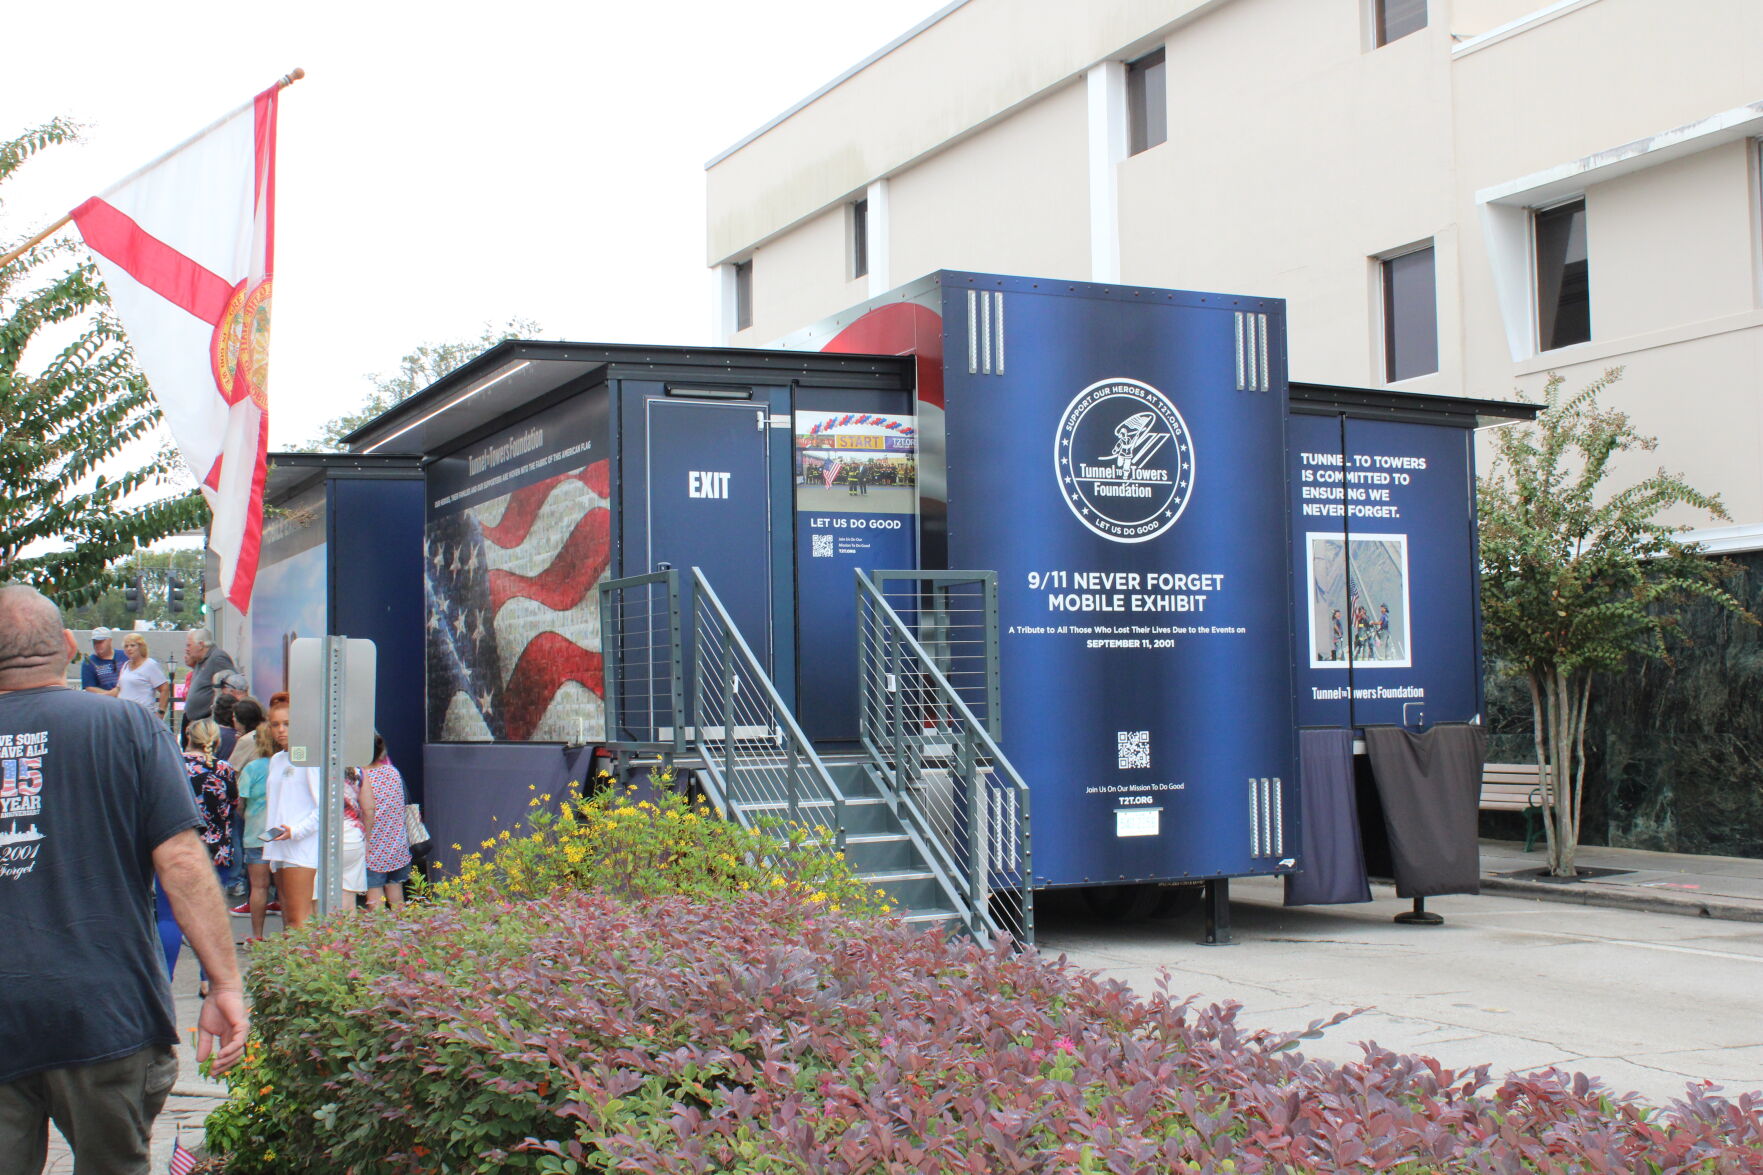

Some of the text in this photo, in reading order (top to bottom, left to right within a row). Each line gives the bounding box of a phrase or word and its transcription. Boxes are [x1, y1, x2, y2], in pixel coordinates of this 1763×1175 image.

[1065, 385, 1182, 436] SUPPORT OUR HEROES AT T2T.ORG
[510, 427, 543, 459] Foundation
[840, 435, 880, 448] START
[548, 455, 554, 464] OF
[553, 451, 562, 462] THIS
[561, 444, 581, 459] AMERICAN
[580, 440, 592, 452] FLAG
[1354, 455, 1371, 467] TO
[1374, 456, 1426, 469] TOWERS
[1080, 463, 1115, 478] Tunnel
[1131, 465, 1168, 480] Towers
[1302, 469, 1410, 485] IS COMMITTED TO
[688, 471, 731, 499] EXIT
[1094, 482, 1152, 498] Foundation
[1302, 486, 1390, 501] ENSURNG WE
[1303, 503, 1400, 518] NEVER FORGET.
[810, 518, 902, 529] LET US DO GOOD
[1095, 518, 1110, 531] LET
[1111, 526, 1122, 535] US
[1136, 520, 1160, 535] GOOD
[1027, 571, 1224, 591] 9/11 NEVER FORGET
[1048, 594, 1207, 612] MOBILE EXHIBIT
[1008, 626, 1245, 634] A Tribute to All Those Who Lost Their Lives Due to the Events on
[1086, 639, 1175, 649] SEPTEMBER 11, 2001
[1312, 687, 1342, 700] Tunnel
[1346, 686, 1377, 699] Twers
[1377, 685, 1424, 699] Foundation
[15, 731, 48, 746] SOME
[0, 743, 48, 758] AVE ALL
[0, 757, 43, 797] 15
[1129, 784, 1151, 792] Mission
[1168, 782, 1185, 790] Good
[0, 795, 42, 813] YEAR
[1119, 795, 1153, 805] T2T.ORG
